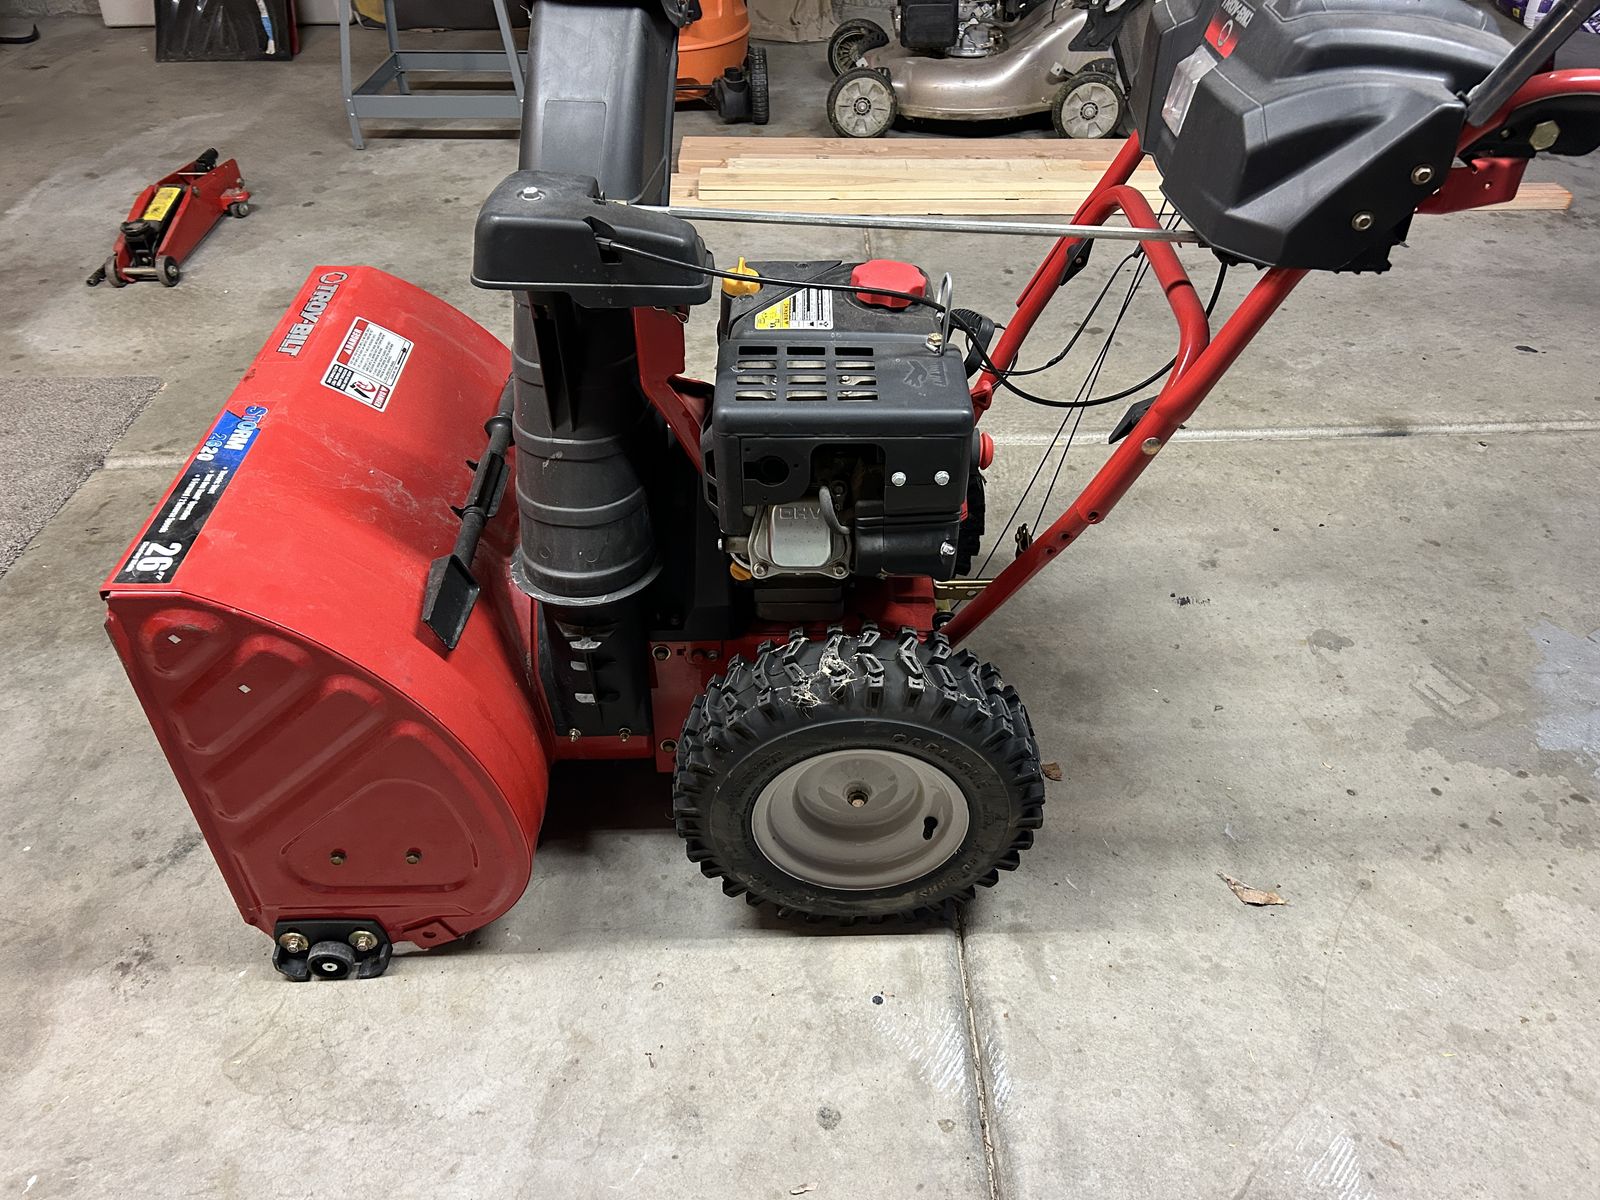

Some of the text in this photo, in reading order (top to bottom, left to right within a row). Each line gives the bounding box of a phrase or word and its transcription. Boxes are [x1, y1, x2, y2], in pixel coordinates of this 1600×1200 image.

[277, 283, 340, 358] TROY-BILT
[345, 328, 363, 352] DANGER
[224, 405, 268, 451] STORM
[196, 432, 227, 461] 2620
[779, 507, 821, 520] OHV
